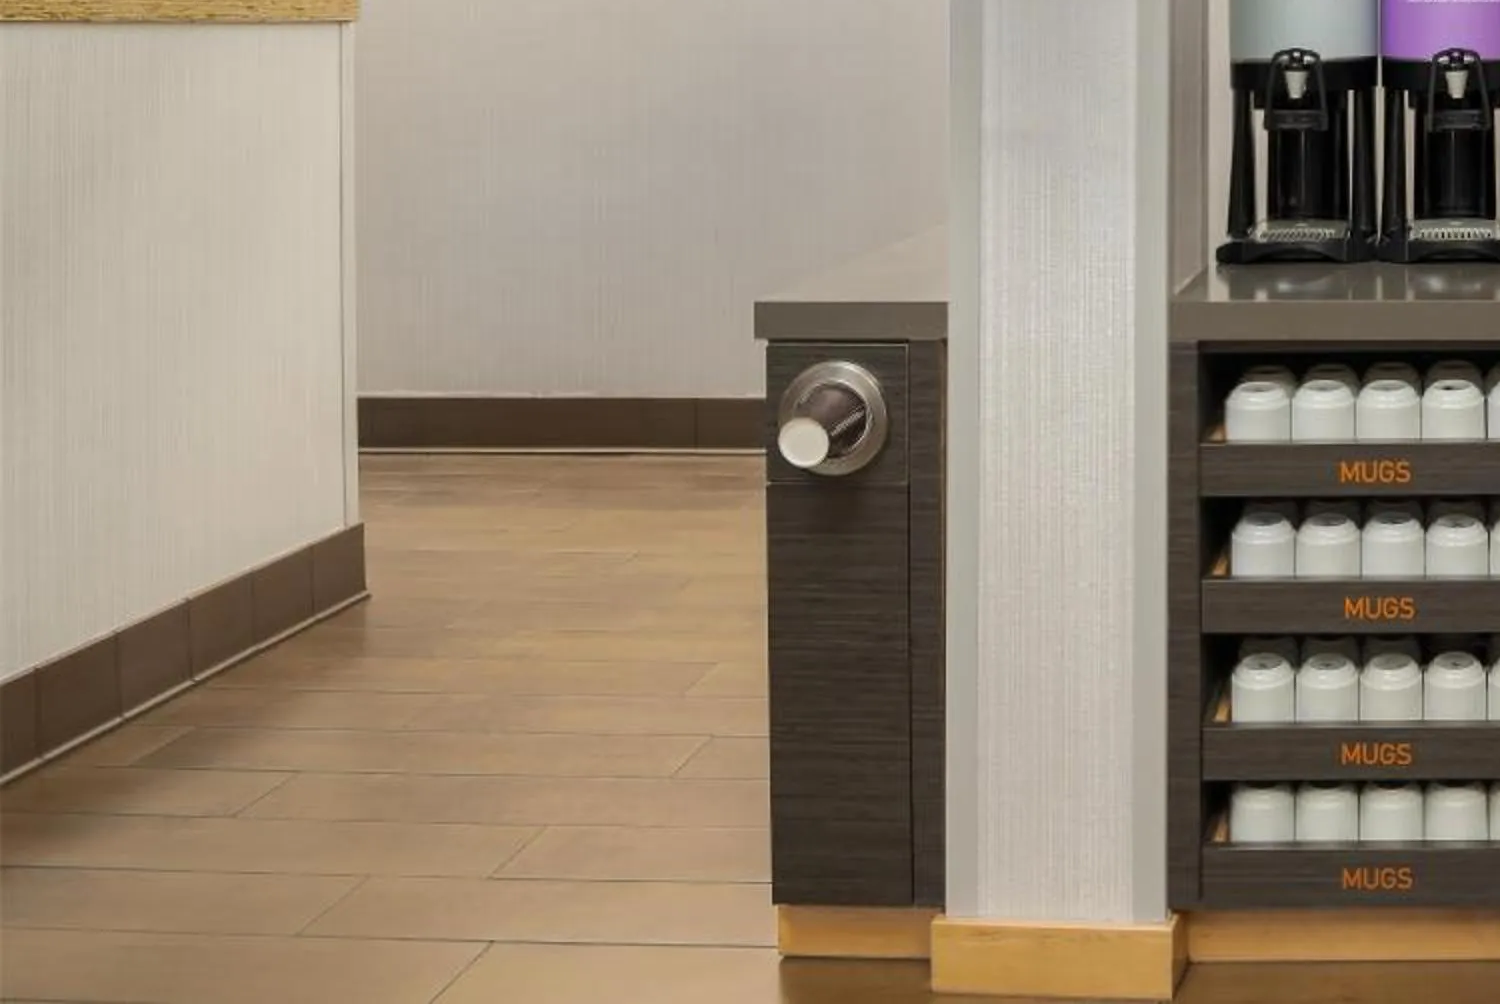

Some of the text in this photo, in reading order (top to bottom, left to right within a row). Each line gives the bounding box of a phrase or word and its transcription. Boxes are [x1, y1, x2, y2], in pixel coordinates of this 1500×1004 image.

[1339, 460, 1411, 484] MUGS
[1343, 597, 1415, 621] MUGS
[1340, 742, 1413, 766] MUGS
[1341, 867, 1413, 890] MUGS
